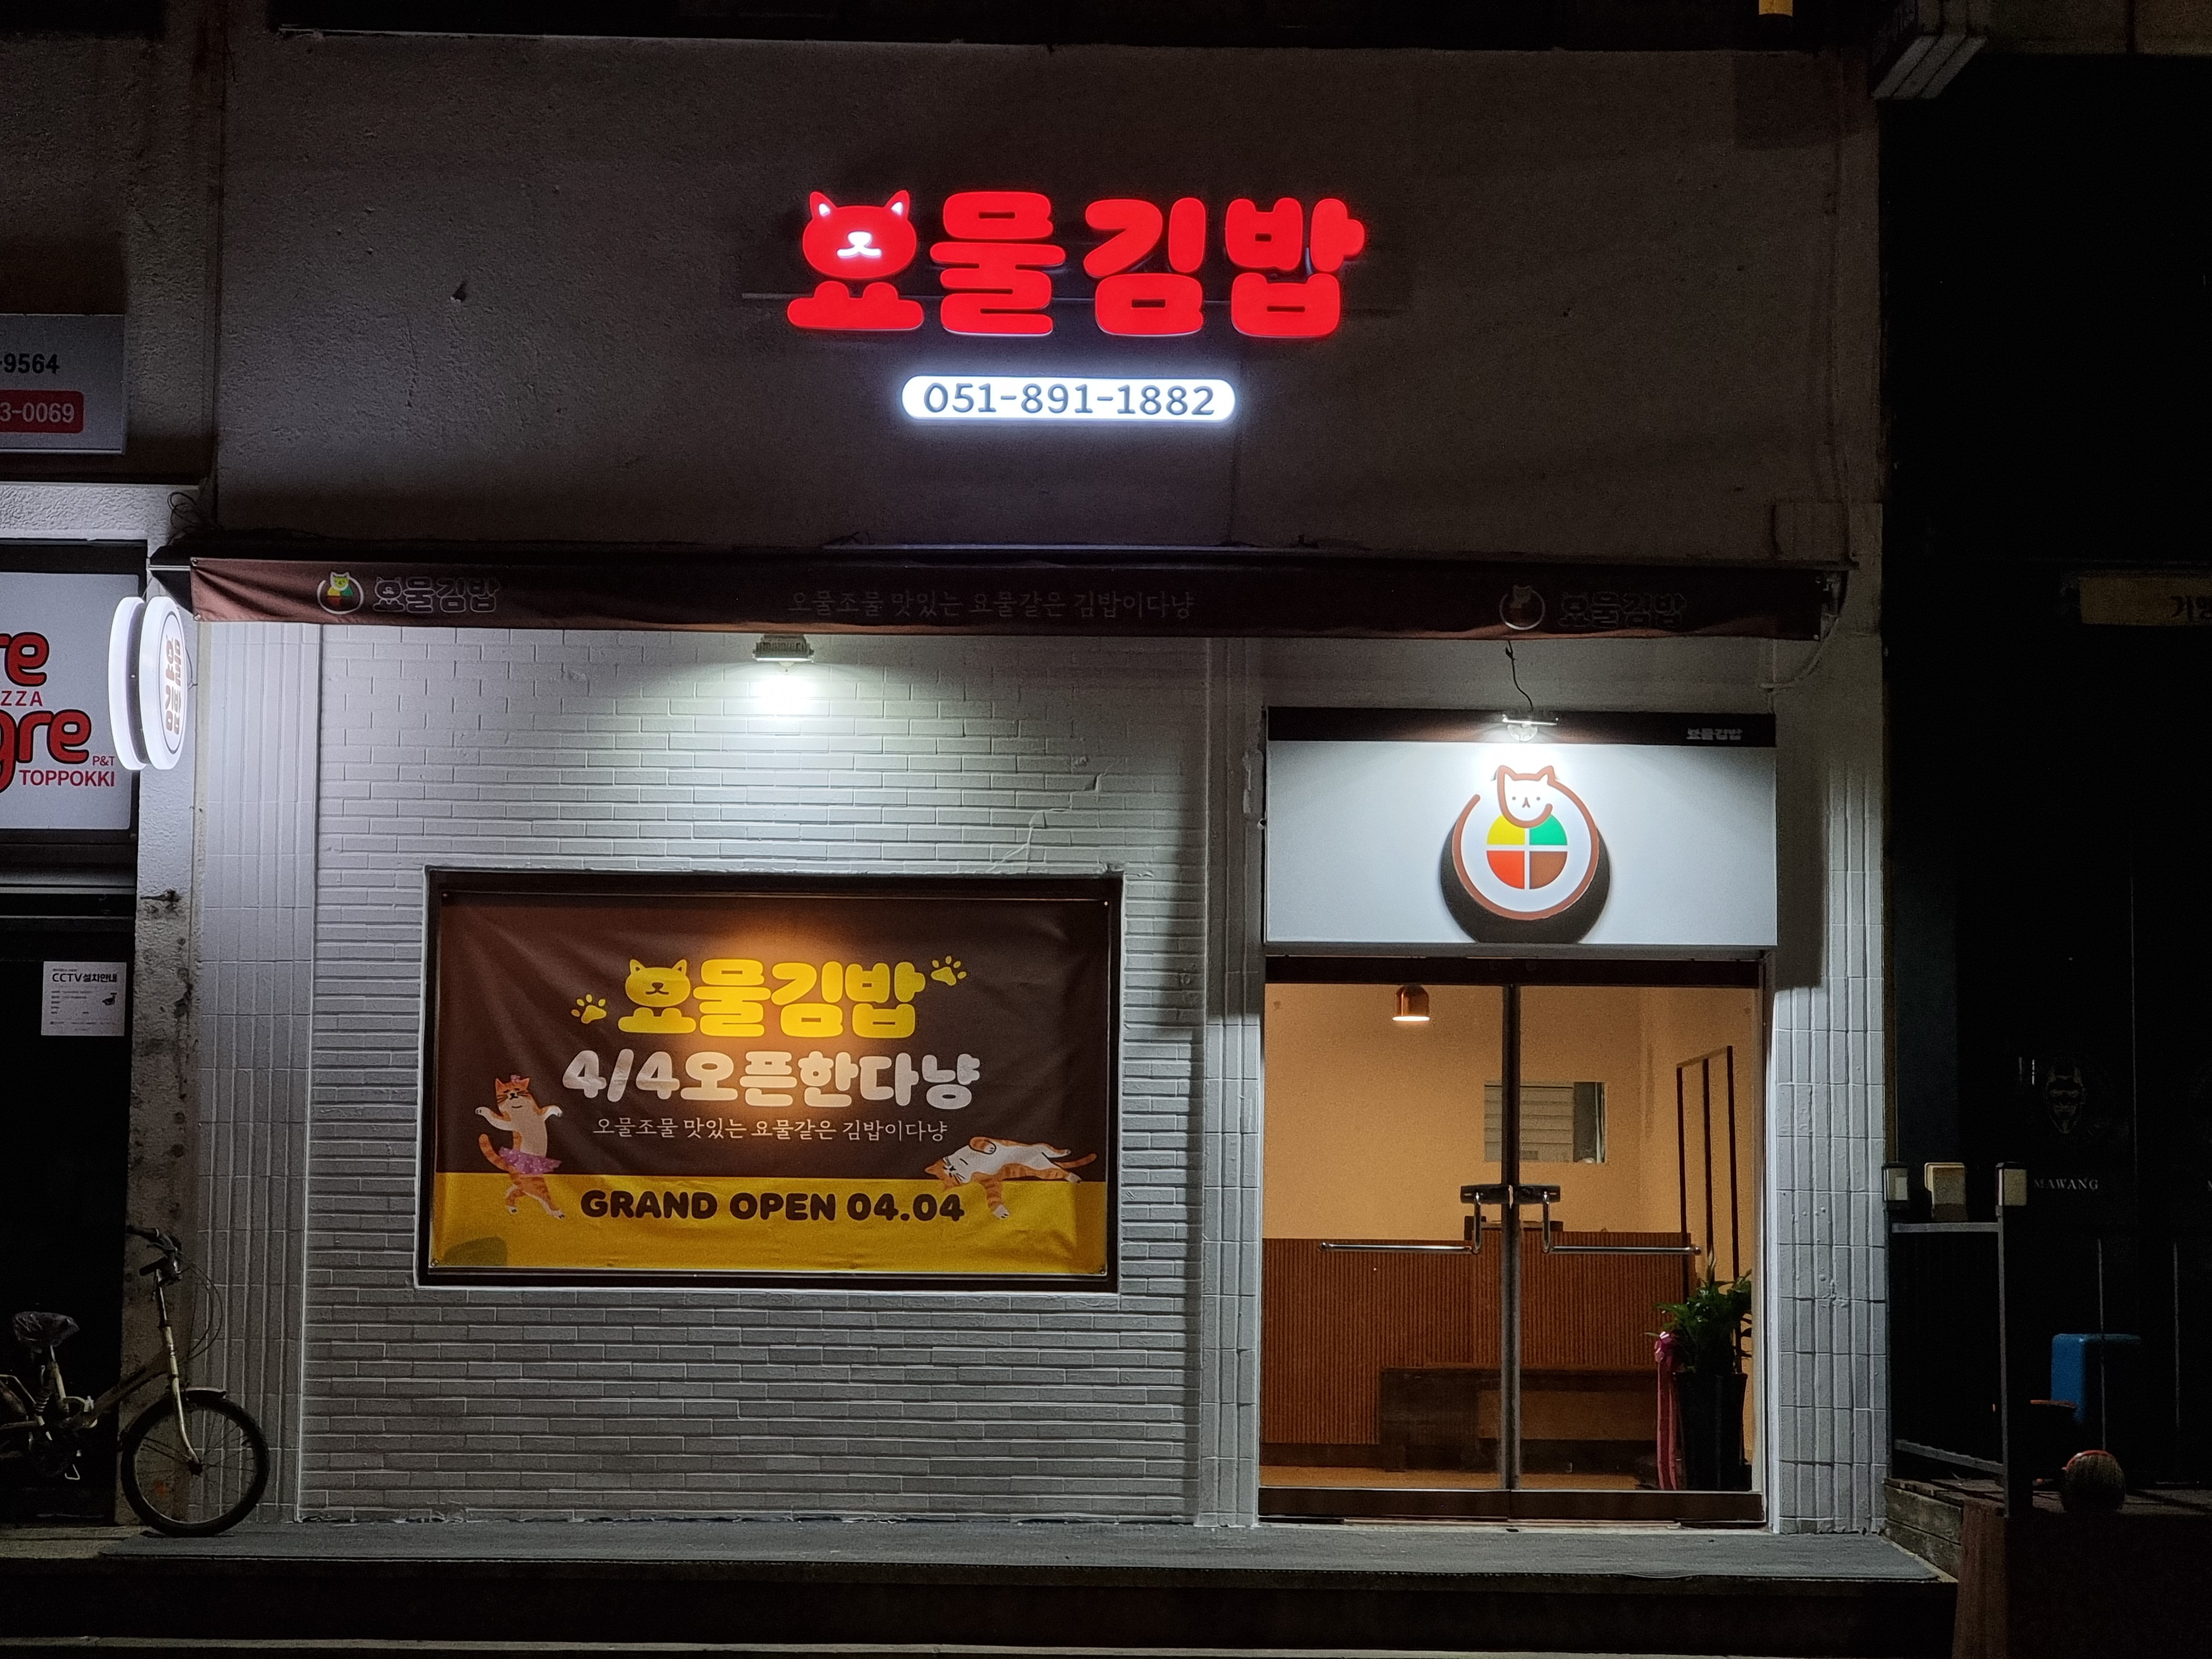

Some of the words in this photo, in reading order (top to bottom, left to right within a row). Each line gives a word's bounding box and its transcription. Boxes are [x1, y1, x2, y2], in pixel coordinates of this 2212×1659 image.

[787, 190, 1365, 337] 요물김밥
[922, 382, 1215, 416] 051-891-1882
[372, 576, 499, 613] 요물김밥
[787, 591, 883, 617] 오물조물
[891, 590, 963, 617] 맛있는
[1074, 590, 1195, 619] 김밥이다냥
[92, 756, 115, 766] P&T
[19, 770, 115, 786] TOPPOKKI
[52, 973, 82, 982] CCTV
[618, 958, 925, 1039] 요물김밥
[562, 1048, 981, 1109] 4/4오픈한다냥
[593, 1117, 679, 1138] 오물조물
[684, 1118, 747, 1139] 맛있는
[751, 1119, 837, 1141] 요물같은
[842, 1120, 948, 1143] 김밥이다냥
[2033, 1178, 2099, 1191] MAWANG
[581, 1190, 718, 1220] GRAND
[729, 1192, 836, 1221] OPEN
[847, 1193, 965, 1222] 04.04
